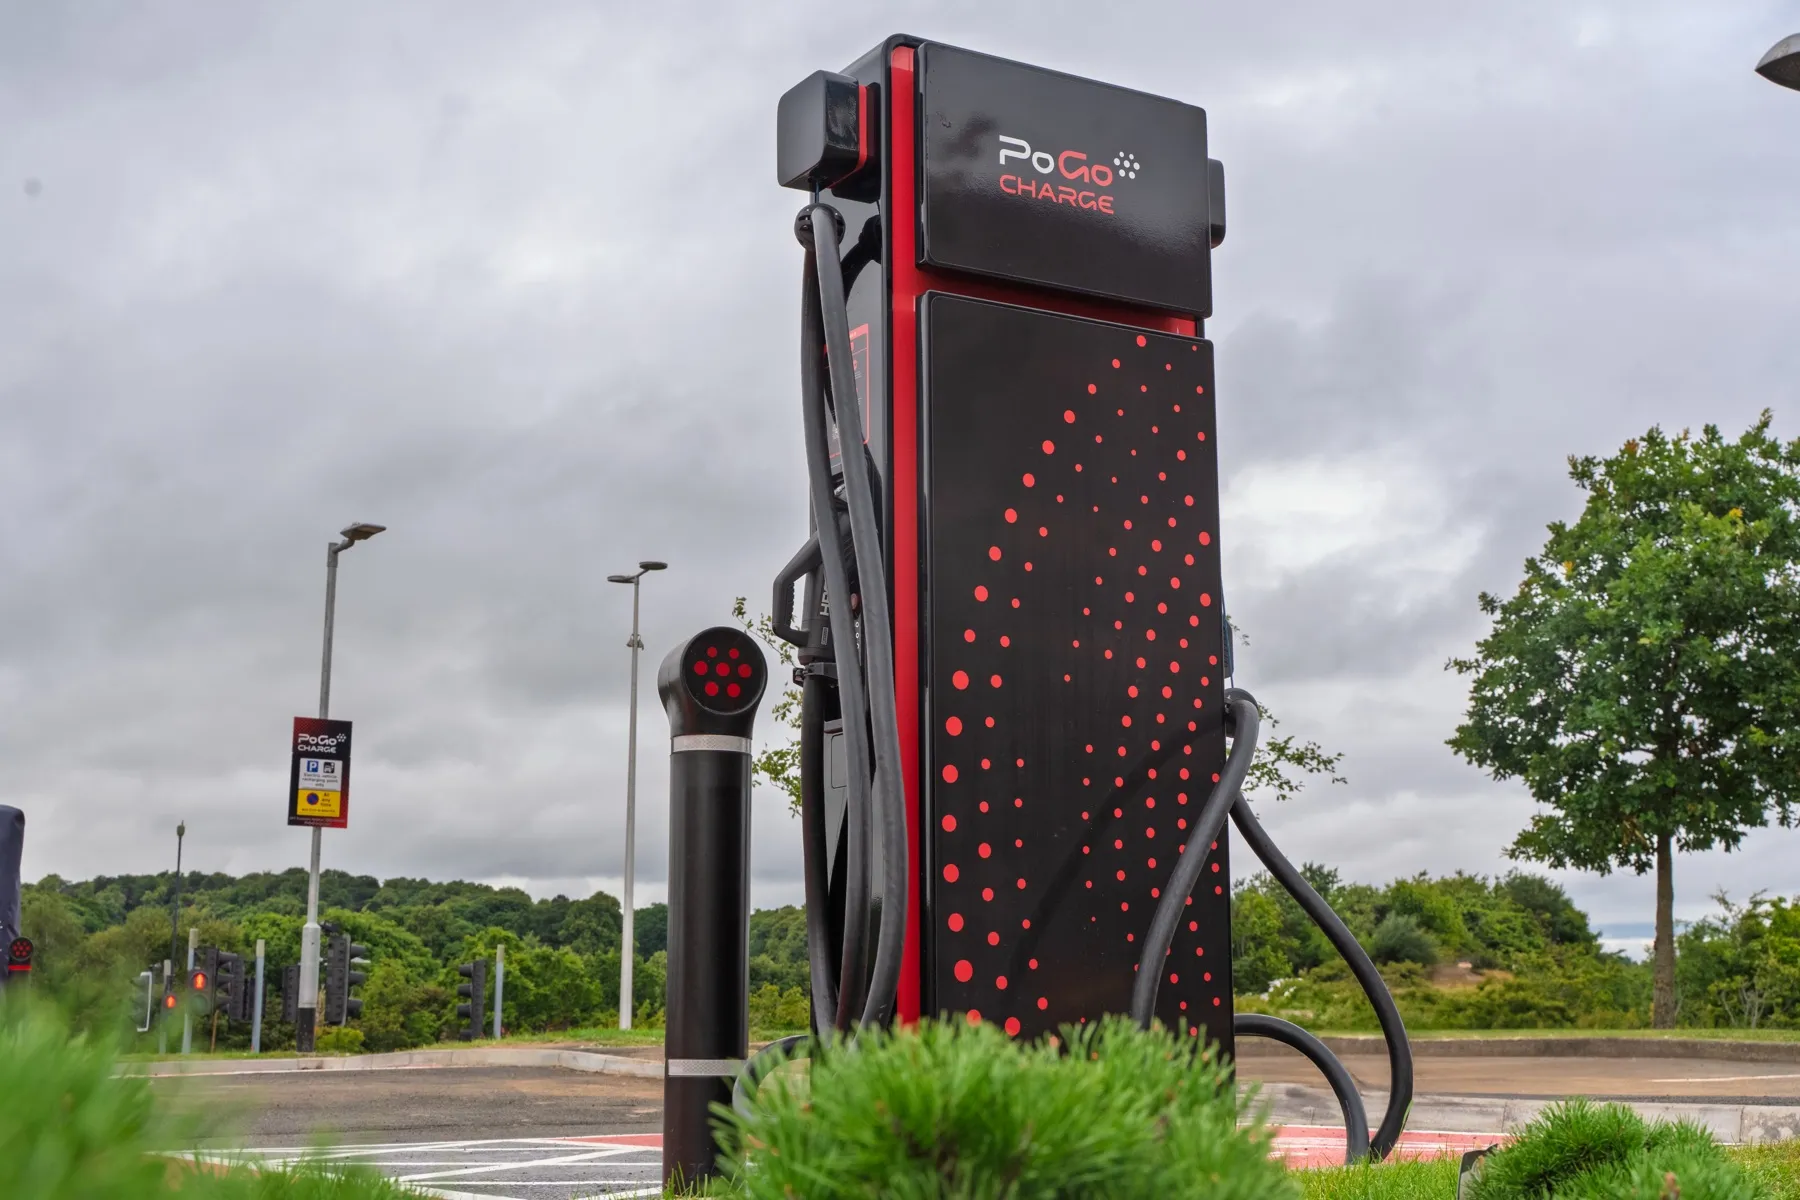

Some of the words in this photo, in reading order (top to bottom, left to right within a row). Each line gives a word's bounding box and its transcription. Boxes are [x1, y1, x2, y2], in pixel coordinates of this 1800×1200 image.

[999, 134, 1113, 187] PoGo
[999, 174, 1114, 215] CHARGE
[297, 744, 337, 753] CHARGE
[298, 733, 337, 745] PoGo
